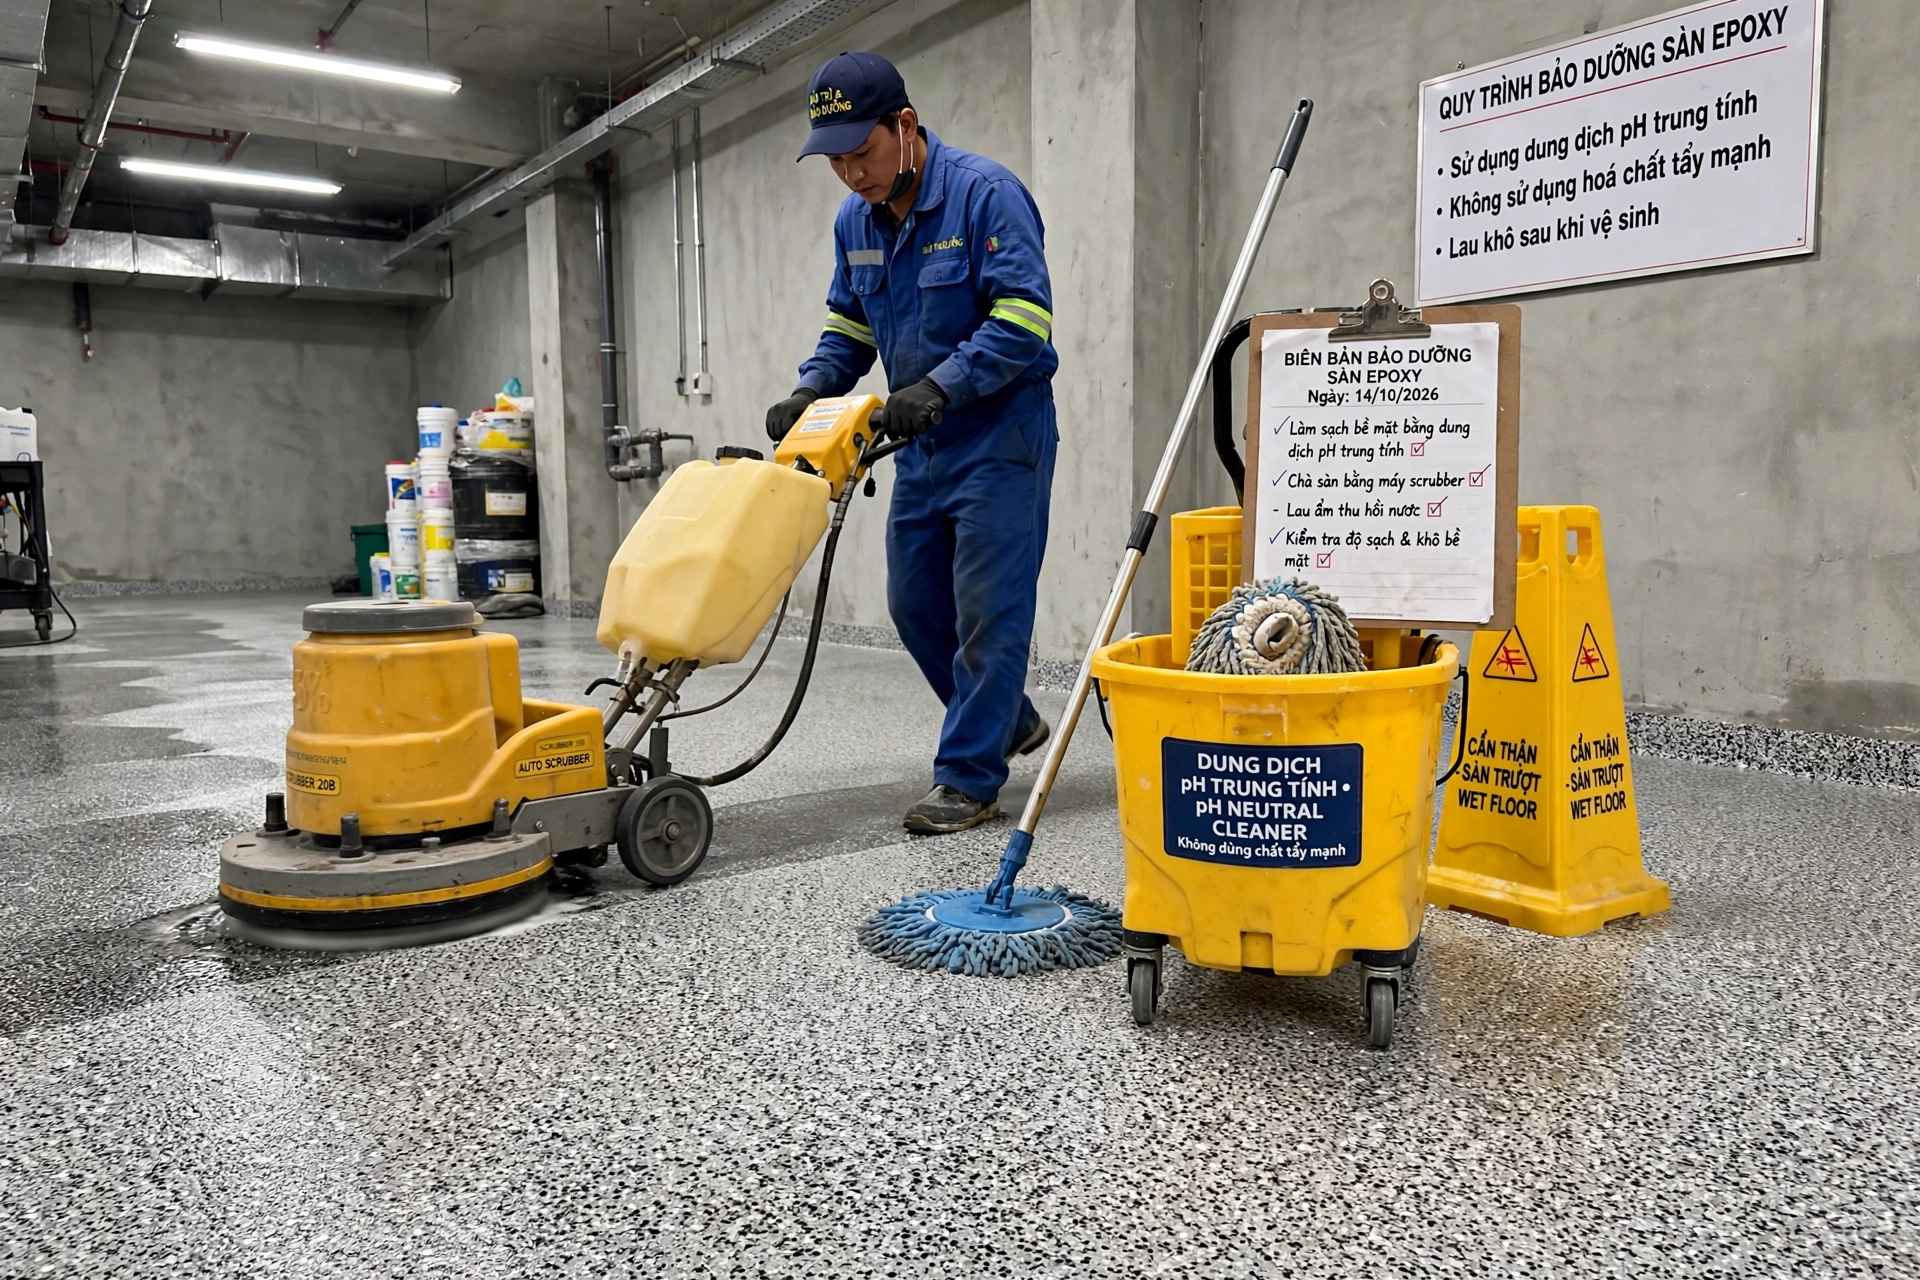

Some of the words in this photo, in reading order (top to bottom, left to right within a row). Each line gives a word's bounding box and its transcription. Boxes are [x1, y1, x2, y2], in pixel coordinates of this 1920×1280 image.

[1439, 89, 1475, 120] QUY
[1479, 74, 1533, 110] TRÌNH
[1538, 57, 1578, 93] BẢO
[1583, 40, 1655, 83] DƯỠNG
[1662, 27, 1705, 63] SÀN
[1712, 5, 1789, 50] EPOXY
[1450, 153, 1474, 179] Sử
[1478, 142, 1519, 174] dụng
[1524, 129, 1569, 162] dung
[1575, 122, 1614, 157] dịch
[1620, 112, 1647, 147] pH
[1653, 99, 1709, 133] trung
[1715, 89, 1758, 121] tính
[1449, 190, 1501, 219] Không
[1507, 175, 1529, 208] sử
[1533, 172, 1576, 202] dụng
[1583, 162, 1616, 193] hoá
[1623, 144, 1666, 184] chất
[1672, 142, 1704, 178] tẩy
[1710, 134, 1771, 172] mạnh
[1449, 234, 1478, 259] Lau
[1483, 226, 1514, 253] khô
[1519, 223, 1551, 248] sau
[1557, 214, 1584, 241] khi
[1590, 210, 1613, 239] vệ
[1618, 202, 1659, 231] sinh
[1284, 349, 1322, 366] BIÊN
[1328, 346, 1363, 365] BẢN
[1368, 346, 1404, 364] BẢO
[1408, 345, 1472, 363] DƯỠNG
[1328, 367, 1361, 384] SÀN
[1367, 369, 1422, 383] EPOXY
[1308, 389, 1349, 406] Ngày:
[1355, 387, 1439, 404] 14/10/2026
[1290, 420, 1316, 435] Làm
[1321, 420, 1349, 438] sạch
[1354, 417, 1370, 435] bề
[1373, 420, 1398, 438] mặt
[1404, 416, 1434, 439] bằng
[1439, 418, 1470, 438] dung
[1288, 444, 1313, 461] dịch
[1319, 444, 1336, 462] pH
[1341, 444, 1374, 462] trung
[1379, 442, 1404, 457] tính
[1288, 473, 1312, 488] Chà
[1317, 471, 1338, 488] sàn
[1344, 470, 1373, 492] bằng
[1379, 472, 1405, 493] máy
[1410, 472, 1465, 487] scrubber
[1287, 502, 1310, 517] Lau
[1315, 499, 1333, 517] ẩm
[1338, 502, 1359, 516] thu
[1365, 499, 1384, 516] hồi
[1286, 527, 1317, 546] Kiểm
[1322, 532, 1340, 546] tra
[1346, 530, 1362, 550] độ
[1366, 531, 1394, 550] sạch
[1401, 532, 1411, 546] &
[1416, 531, 1440, 546] khô
[1445, 528, 1461, 546] bề
[1285, 552, 1310, 572] mặt
[1500, 739, 1537, 767] THẬN
[1593, 733, 1619, 760] THẬN
[519, 761, 542, 773] AUTO
[545, 753, 590, 768] SCRUBBER
[1197, 753, 1260, 774] DUNG
[1267, 757, 1321, 778] DỊCH
[318, 778, 335, 791] 20B
[1181, 776, 1206, 794] pH
[1211, 778, 1282, 797] TRUNG
[1288, 777, 1337, 797] TÍNH
[1462, 760, 1490, 784] SÀN
[1494, 769, 1541, 795] TRƯỢT
[1571, 767, 1590, 792] SÀN
[1592, 763, 1624, 788] TRƯỢT
[1196, 798, 1222, 817] pH
[1228, 801, 1323, 819] NEUTRAL
[1459, 788, 1487, 810] WET
[1490, 794, 1537, 820] FLOOR
[1570, 798, 1591, 820] WET
[1594, 791, 1626, 815] FLOOR
[1212, 820, 1307, 840] CLEANER
[1178, 836, 1216, 855] Không
[1219, 842, 1251, 859] dùng
[1255, 843, 1283, 857] chất
[1286, 842, 1307, 860] tẩy
[1311, 844, 1346, 860] mạnh
